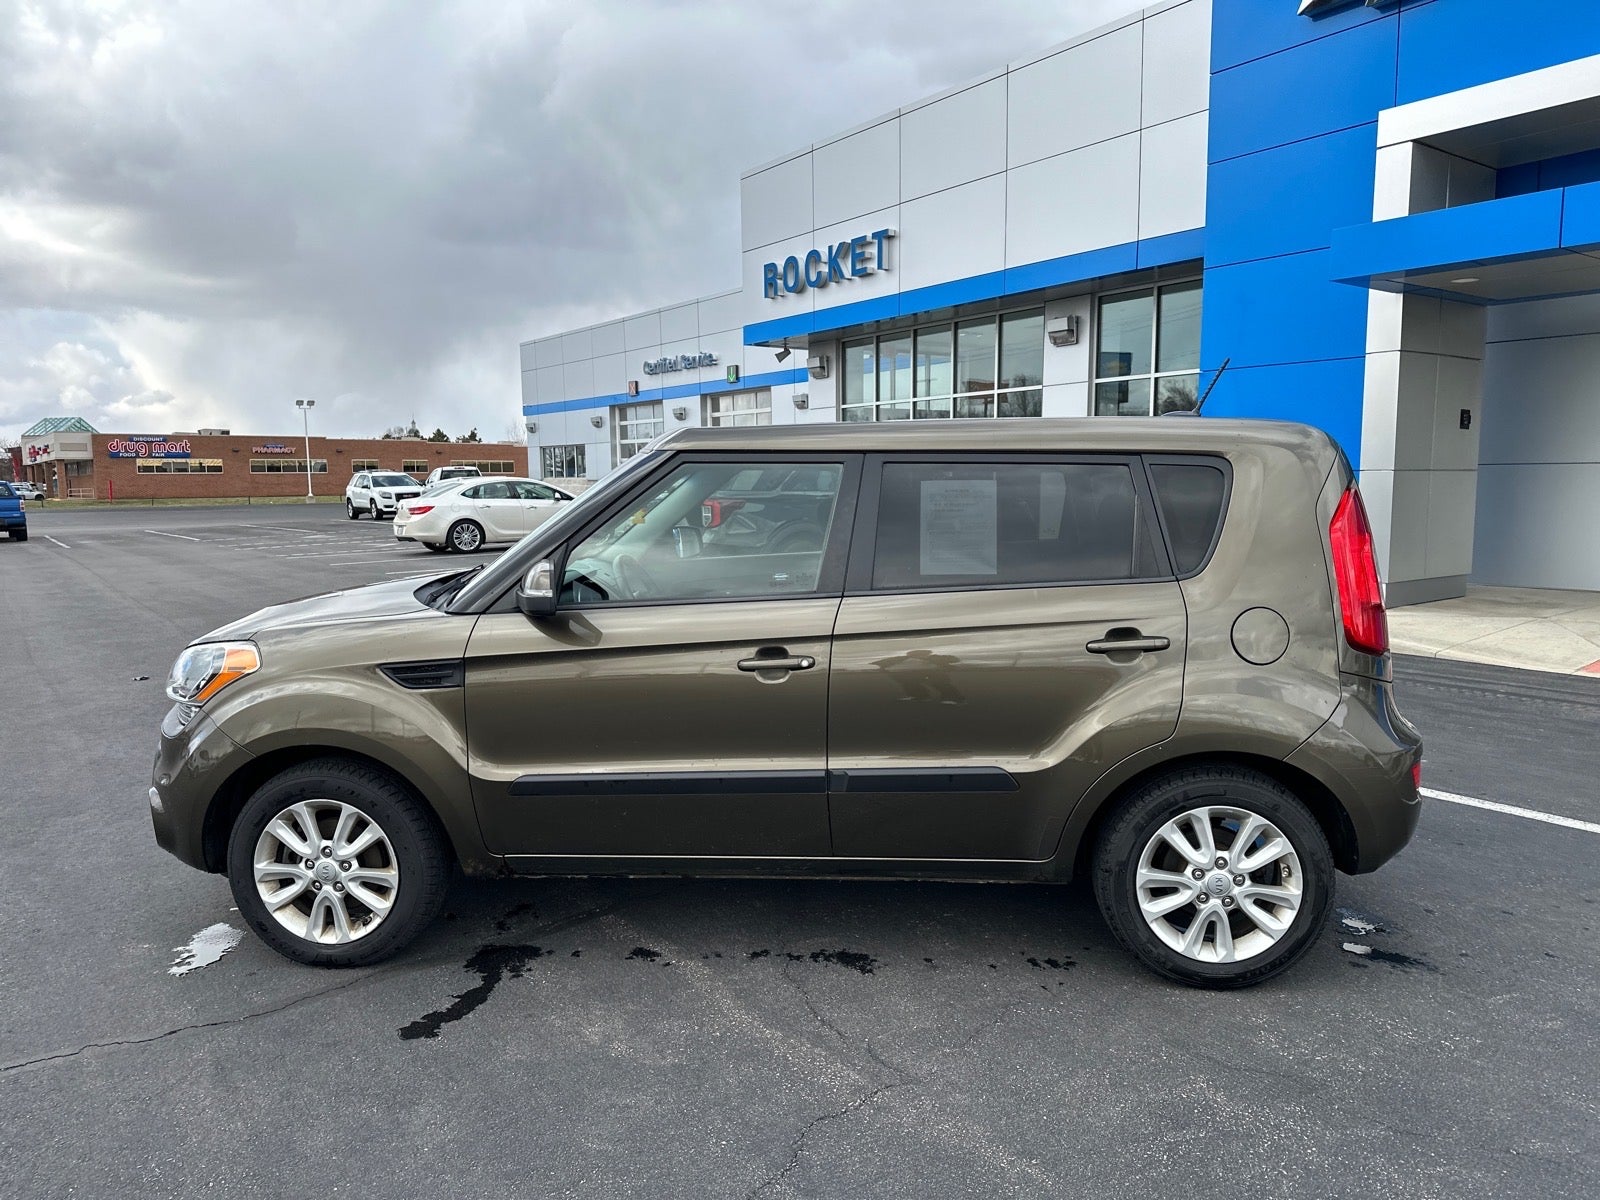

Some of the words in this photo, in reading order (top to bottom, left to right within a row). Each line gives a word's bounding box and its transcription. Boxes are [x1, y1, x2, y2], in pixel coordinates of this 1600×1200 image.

[763, 228, 895, 299] ROCKET
[643, 355, 681, 375] Certified
[680, 351, 719, 369] Service
[107, 438, 149, 458] drug
[152, 439, 192, 453] mart
[251, 446, 297, 454] PHARMACY
[1215, 877, 1224, 894] KIA
